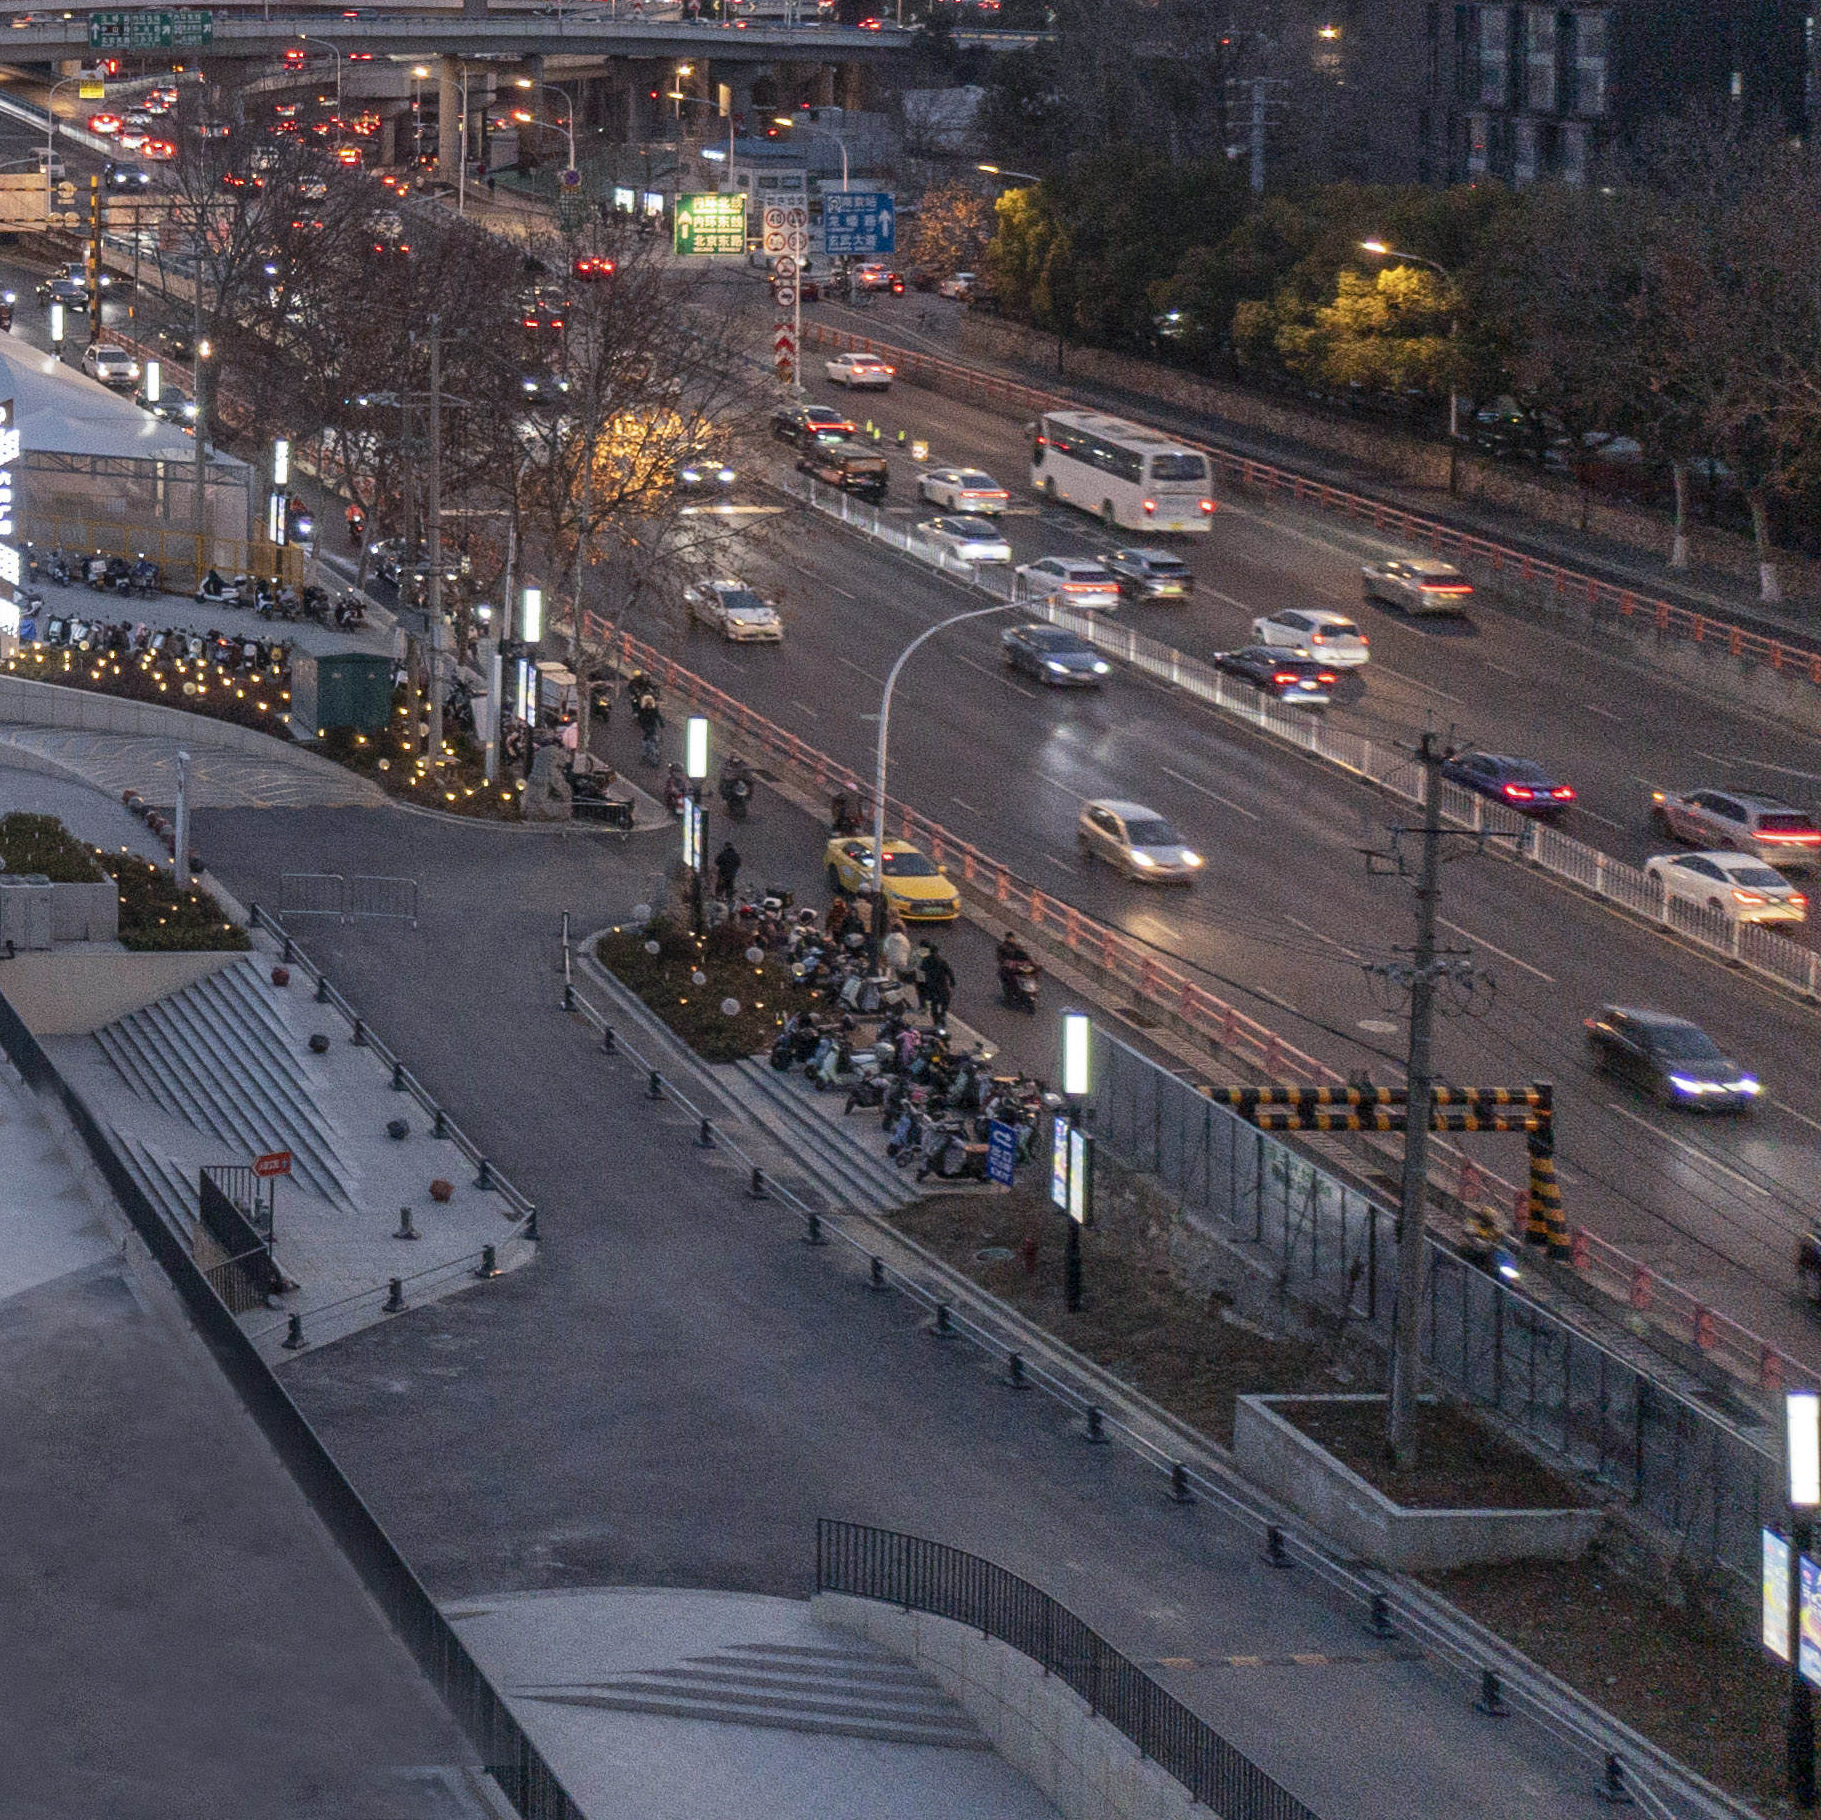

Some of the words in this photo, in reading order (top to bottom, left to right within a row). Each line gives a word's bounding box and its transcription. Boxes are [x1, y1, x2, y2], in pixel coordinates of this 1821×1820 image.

[693, 196, 743, 209] 内环北线
[842, 195, 877, 207] 南京站
[693, 215, 743, 228] 内环东线
[770, 213, 782, 224] 40
[694, 234, 743, 247] 北京东路
[829, 234, 877, 246] 玄武大道
